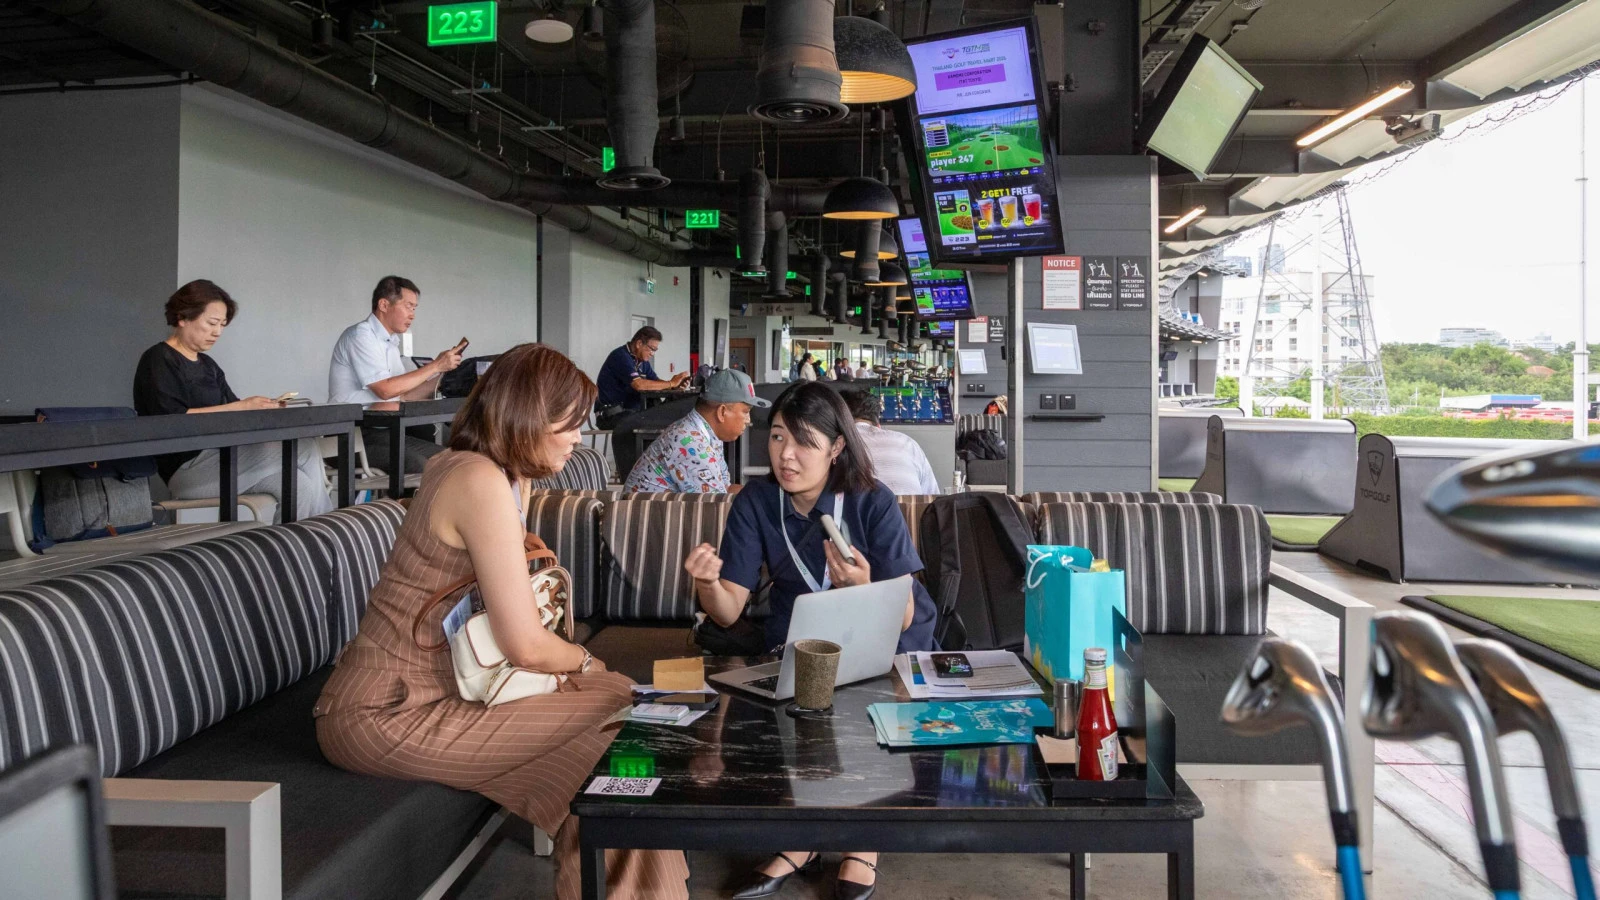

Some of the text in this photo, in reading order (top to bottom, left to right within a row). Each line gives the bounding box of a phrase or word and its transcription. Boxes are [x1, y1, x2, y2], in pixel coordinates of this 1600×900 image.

[438, 10, 483, 34] 223
[930, 154, 974, 168] player 247
[988, 189, 1005, 198] GET
[1011, 186, 1033, 196] FREE
[691, 213, 713, 224] 221
[1360, 488, 1391, 503] TOPGOLF
